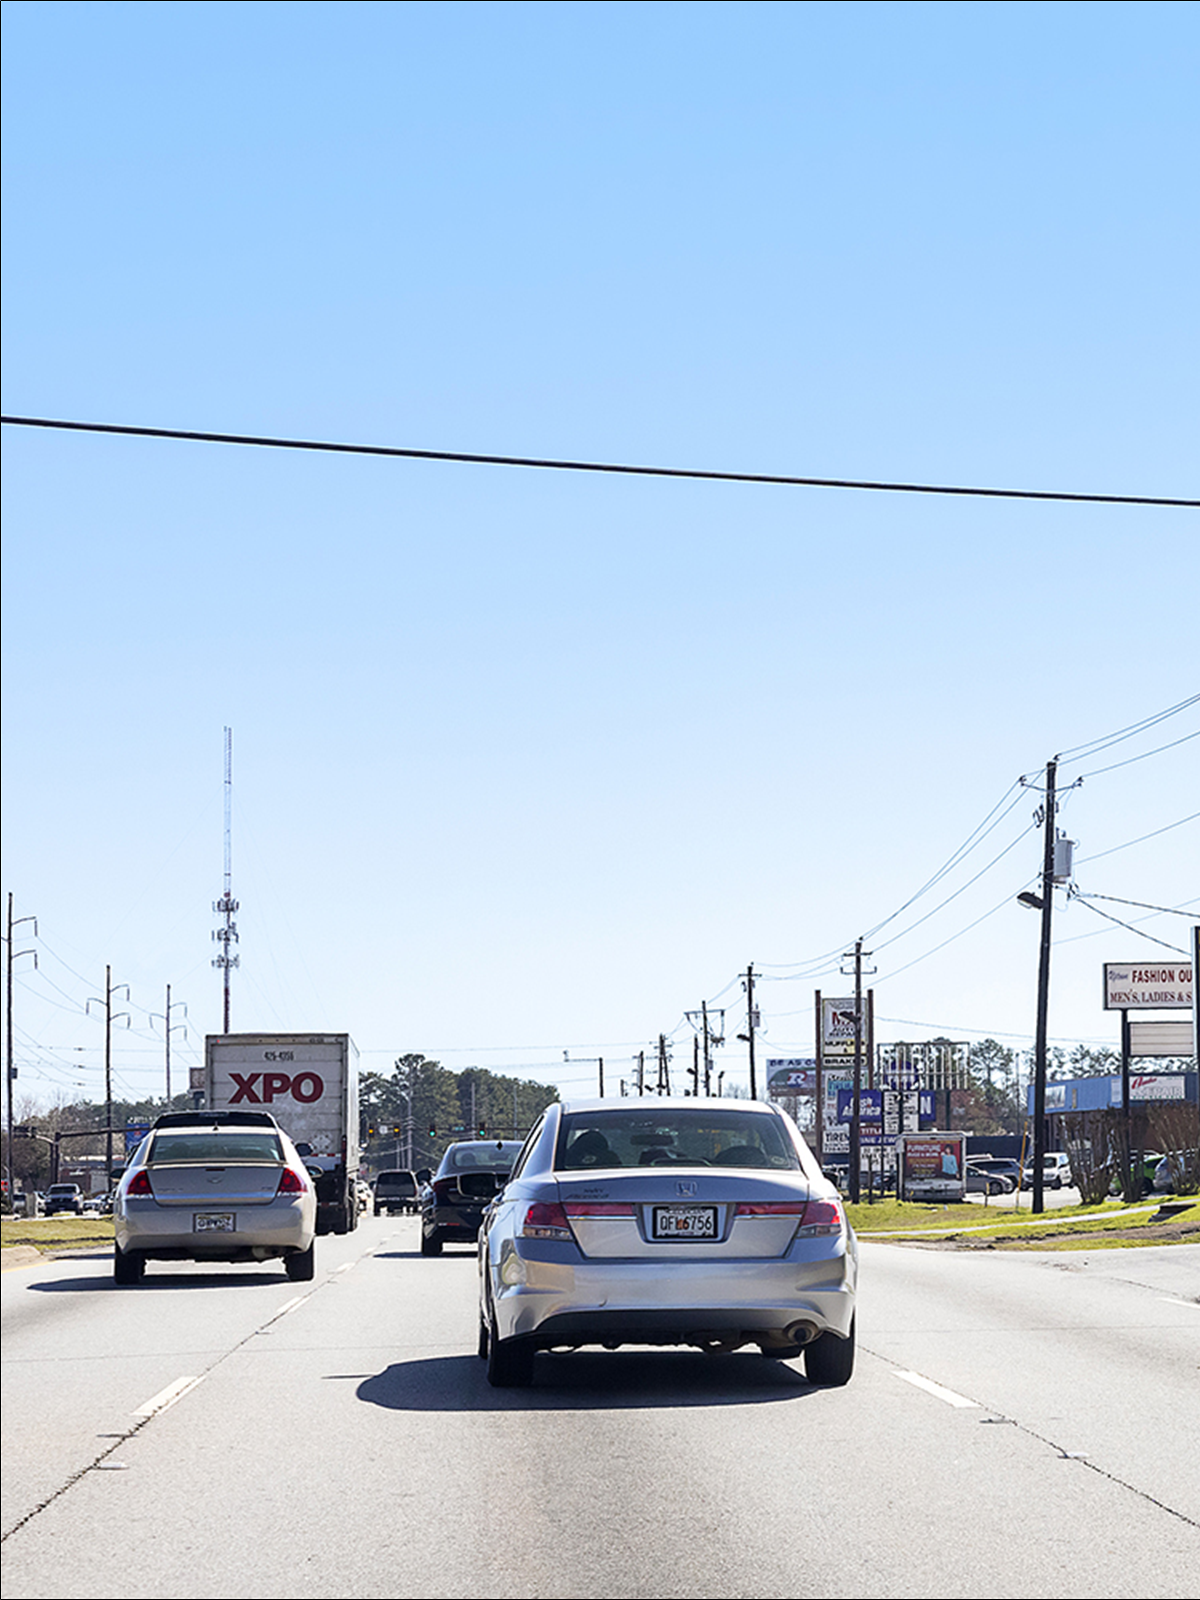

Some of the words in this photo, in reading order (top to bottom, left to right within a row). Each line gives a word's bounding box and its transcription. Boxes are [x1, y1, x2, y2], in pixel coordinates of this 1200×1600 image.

[1131, 969, 1175, 983] FASHION
[1178, 969, 1193, 983] OU
[1142, 991, 1176, 1003] LADIES
[1186, 992, 1193, 1002] S
[227, 1071, 325, 1104] XPO
